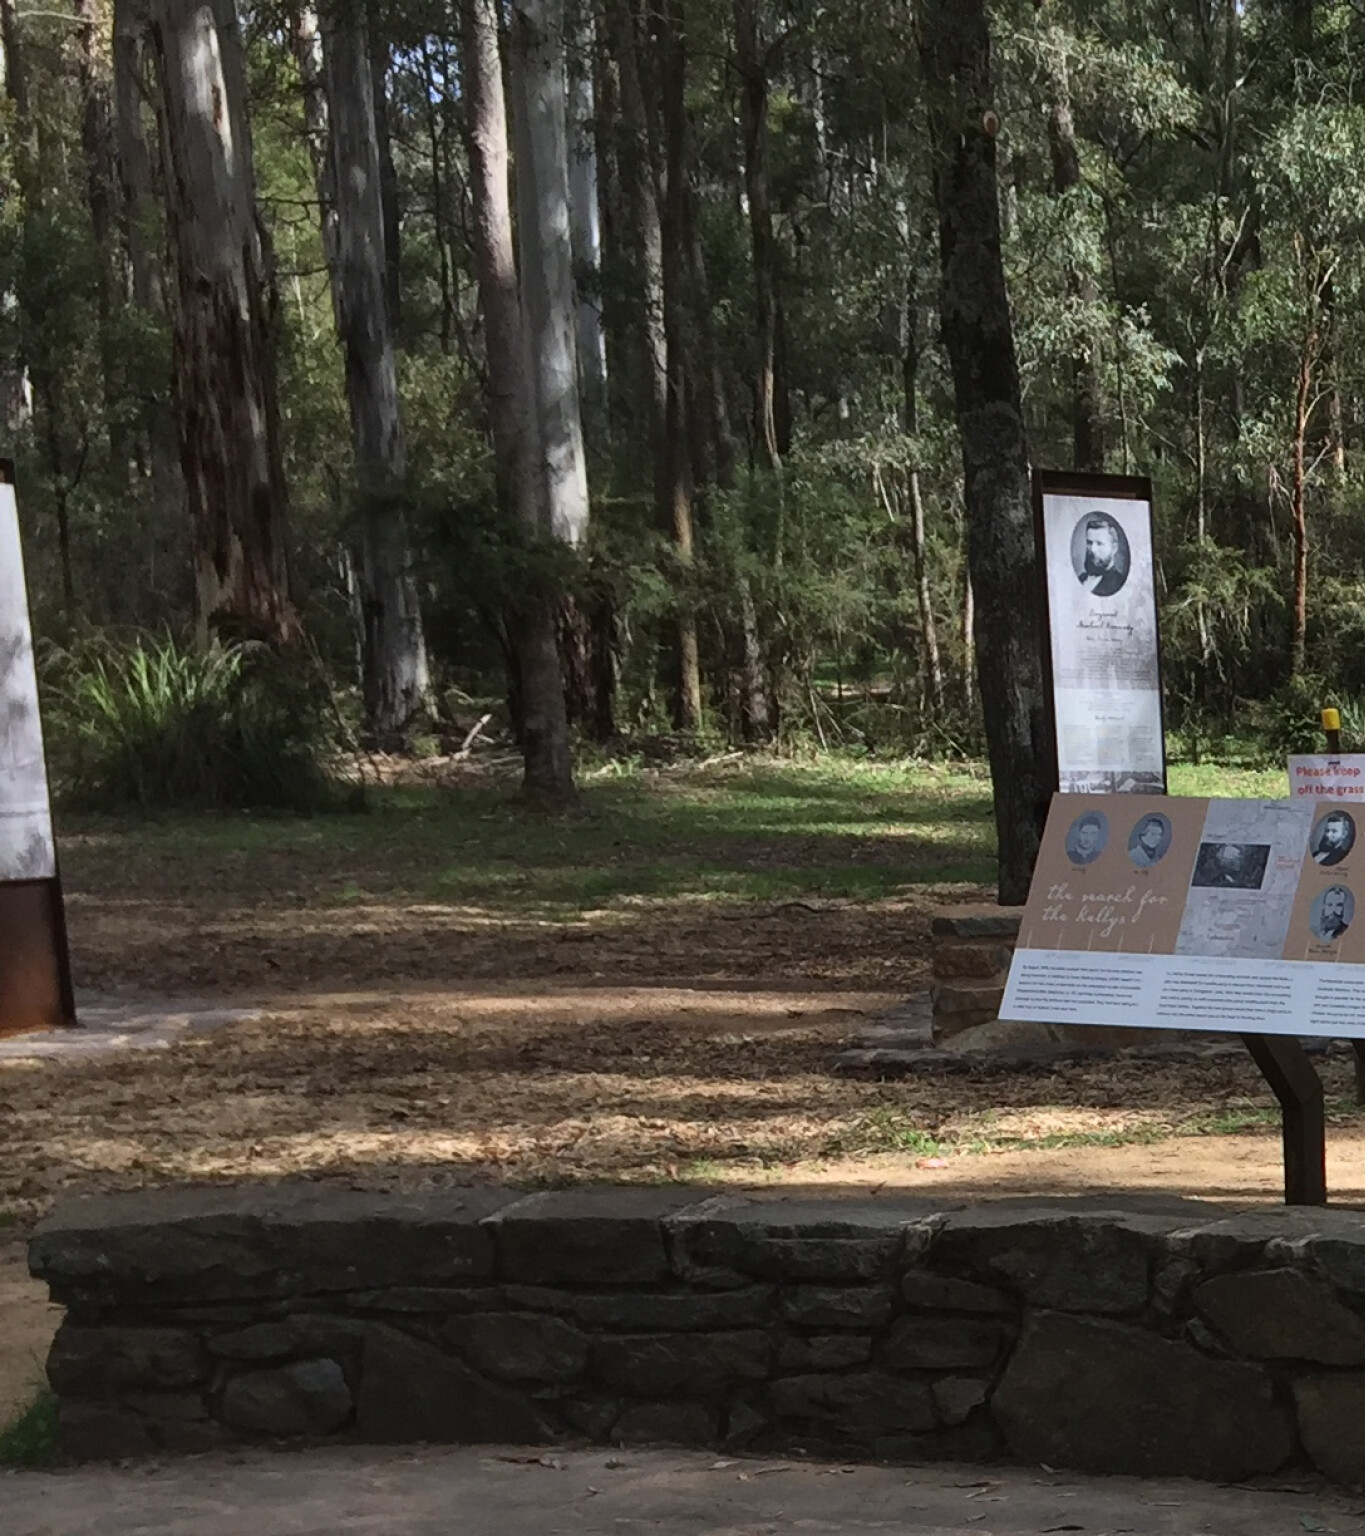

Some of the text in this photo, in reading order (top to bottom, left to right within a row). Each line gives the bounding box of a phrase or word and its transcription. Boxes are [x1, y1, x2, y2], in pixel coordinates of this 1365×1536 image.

[1295, 766, 1361, 778] Please keep
[1297, 784, 1364, 797] off the grass
[1047, 882, 1168, 924] the search for
[1042, 903, 1068, 922] the
